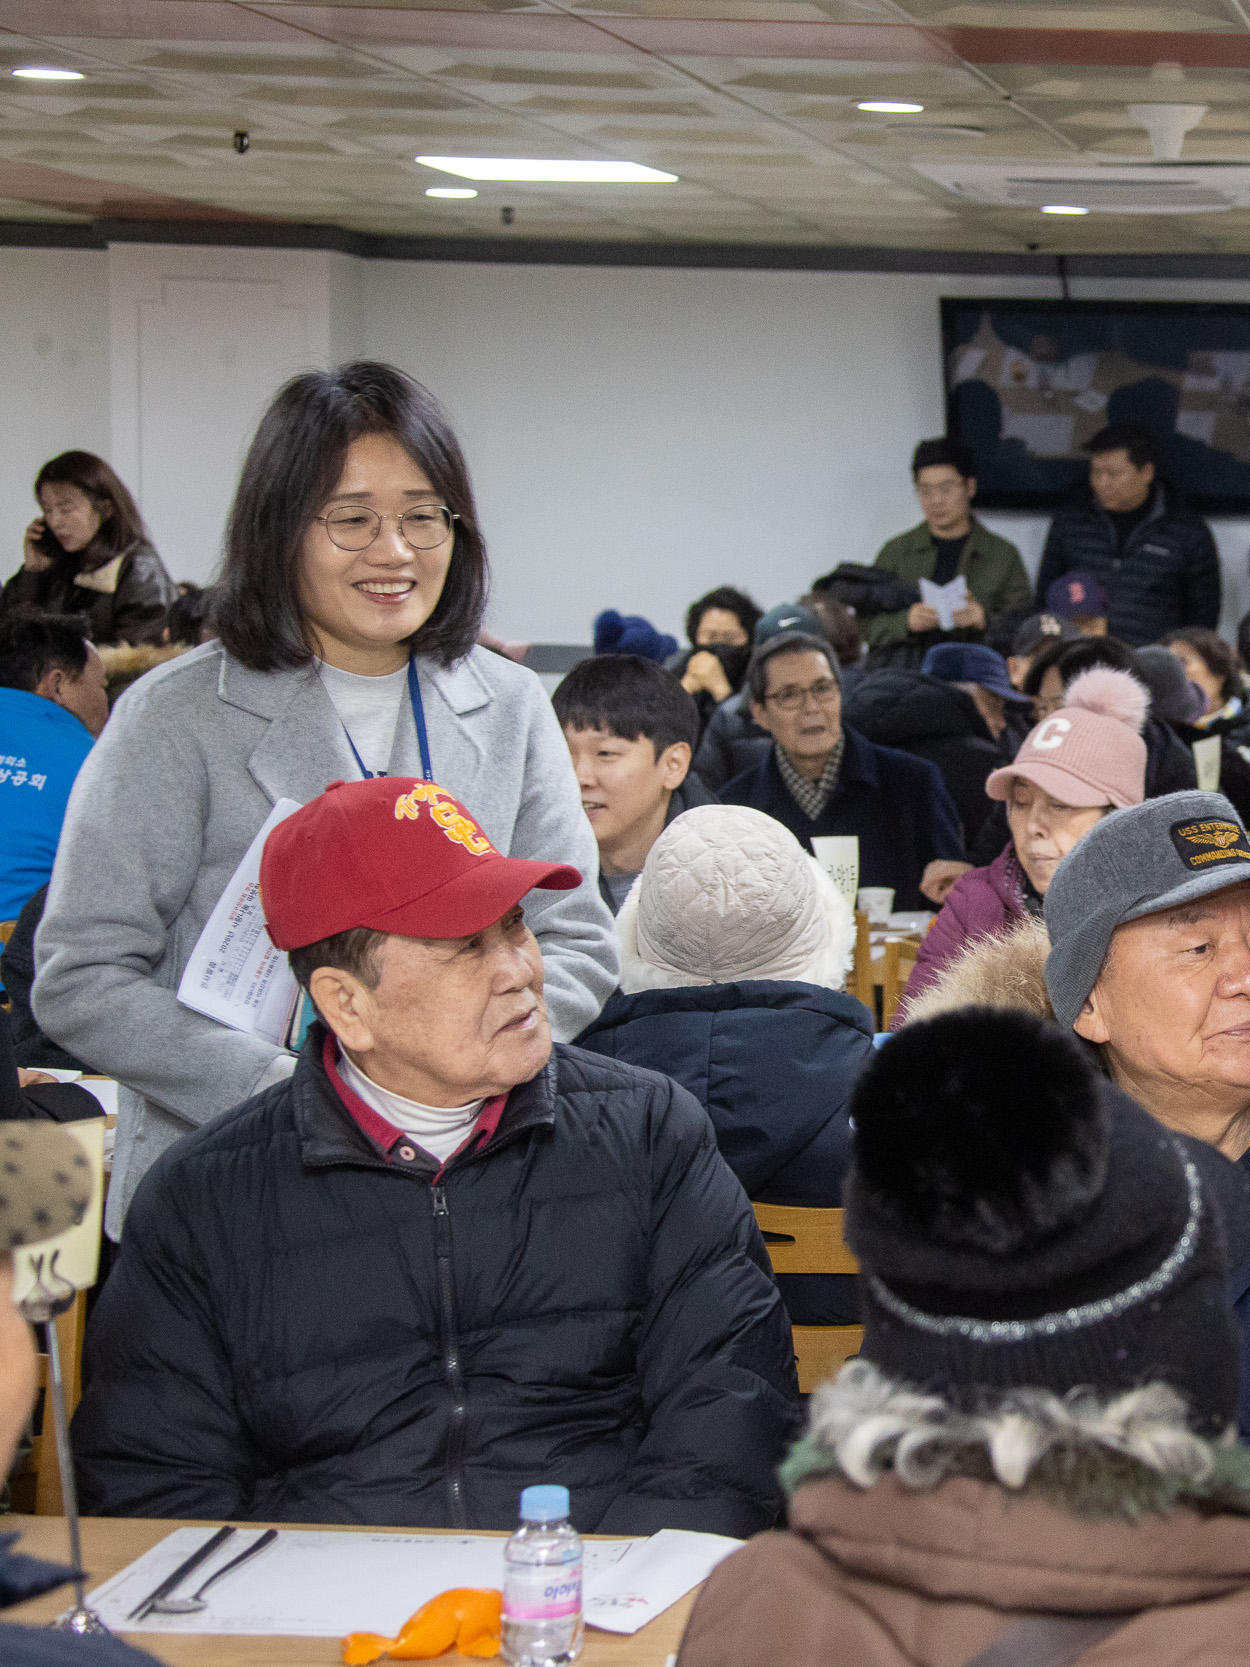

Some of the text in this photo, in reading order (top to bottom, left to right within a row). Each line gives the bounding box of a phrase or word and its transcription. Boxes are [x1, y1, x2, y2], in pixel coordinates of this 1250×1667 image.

[1032, 717, 1071, 750] C
[1177, 824, 1200, 837] USS
[219, 931, 235, 953] 2026년
[232, 904, 249, 928] 사랑나눔
